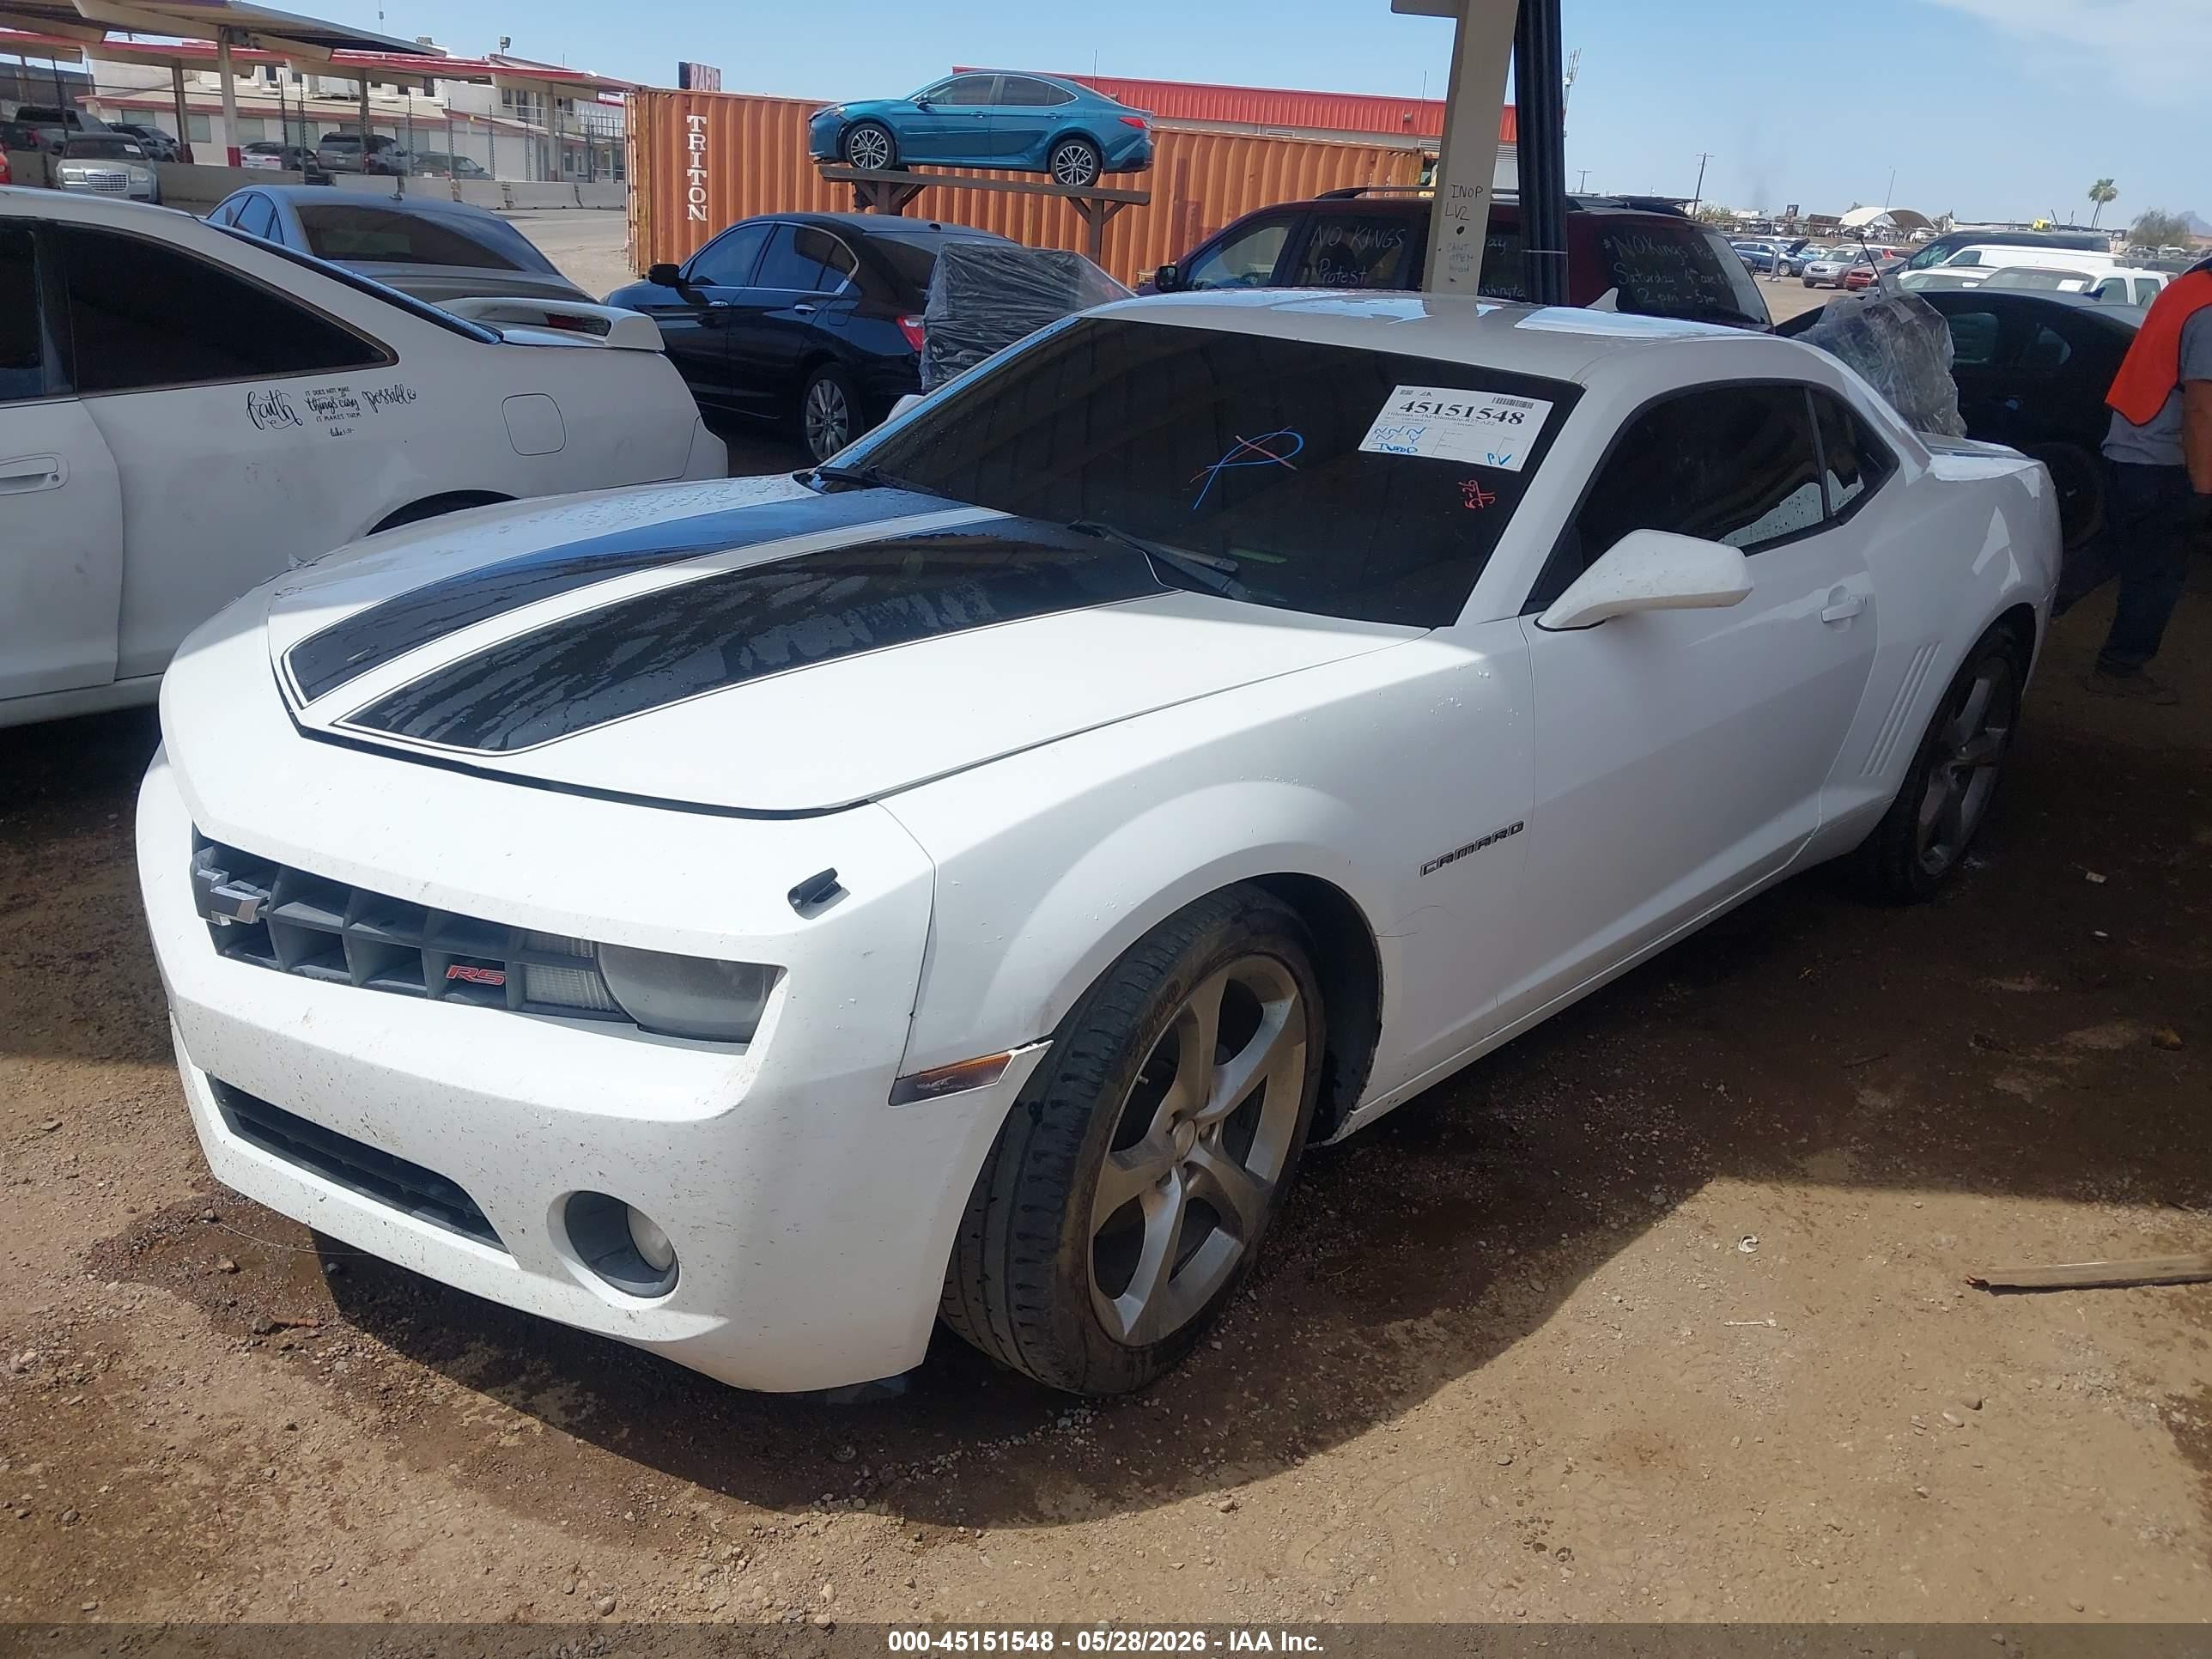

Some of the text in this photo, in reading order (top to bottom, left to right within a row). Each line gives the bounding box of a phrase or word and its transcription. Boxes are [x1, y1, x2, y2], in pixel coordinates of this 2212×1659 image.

[686, 114, 708, 221] TRITON
[1450, 184, 1484, 198] INOP
[1310, 224, 1407, 252] NO KINGS
[1318, 257, 1368, 284] Protest
[303, 396, 361, 415] things easy
[362, 384, 416, 413] possible
[1399, 400, 1526, 425] 45151548
[1419, 819, 1525, 877] CAMARO
[446, 964, 507, 986] RS
